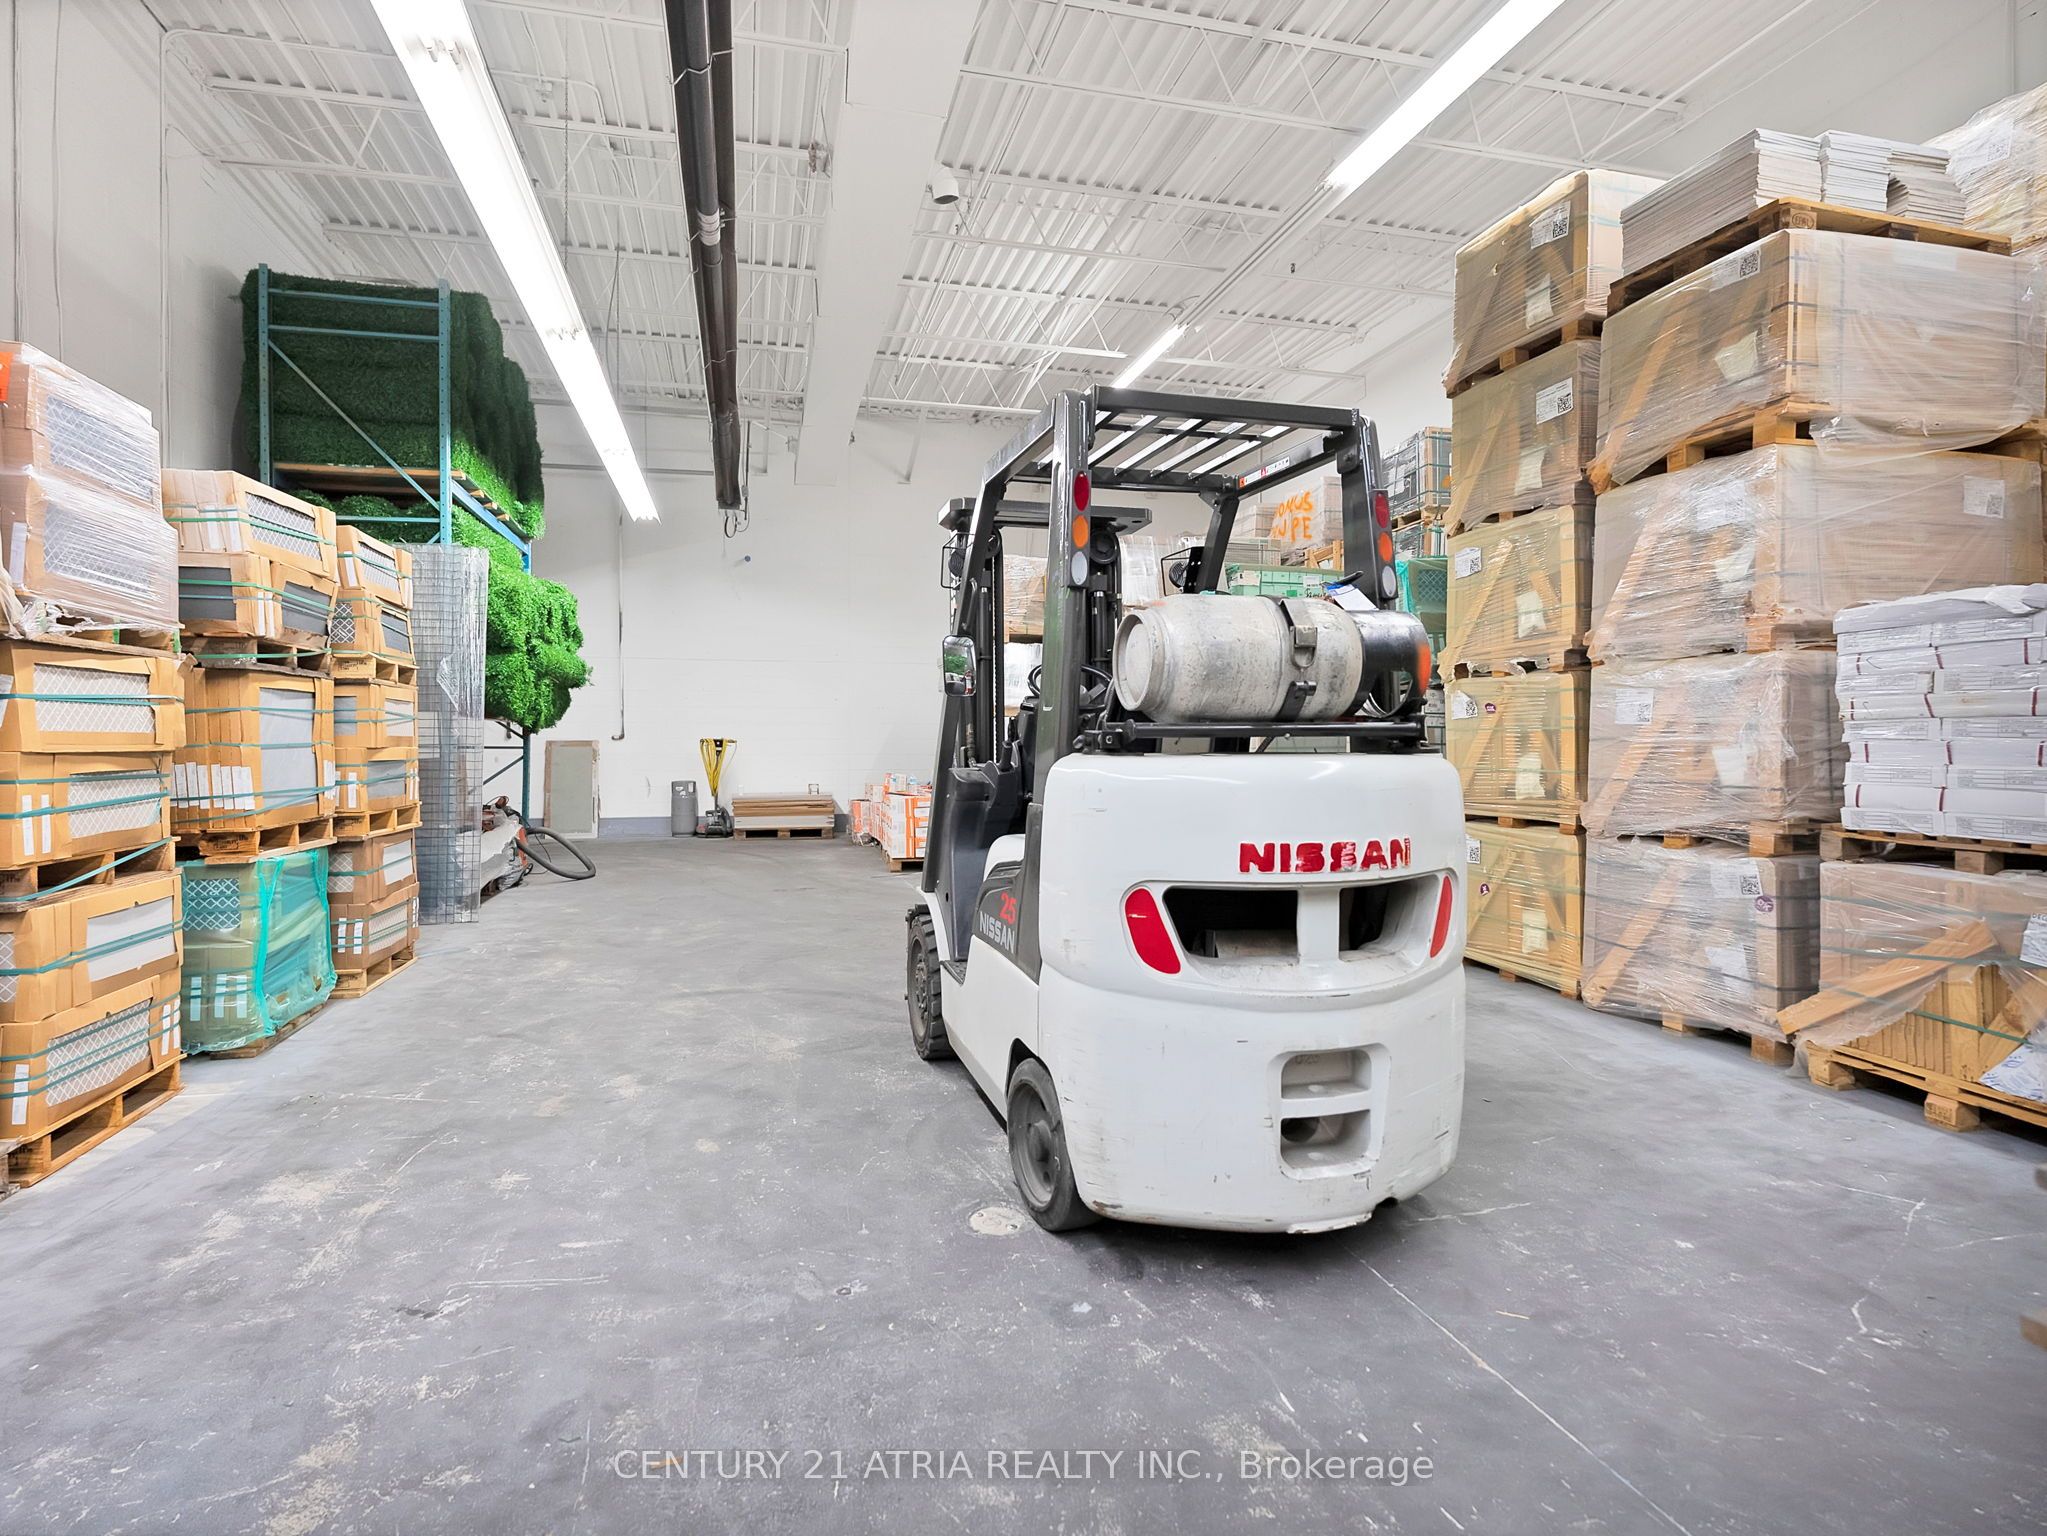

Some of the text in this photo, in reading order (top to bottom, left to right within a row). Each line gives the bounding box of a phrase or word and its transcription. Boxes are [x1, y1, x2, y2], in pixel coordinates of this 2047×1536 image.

[1239, 838, 1411, 873] NISSAN
[999, 891, 1017, 926] 25
[979, 910, 1015, 954] NISSAN
